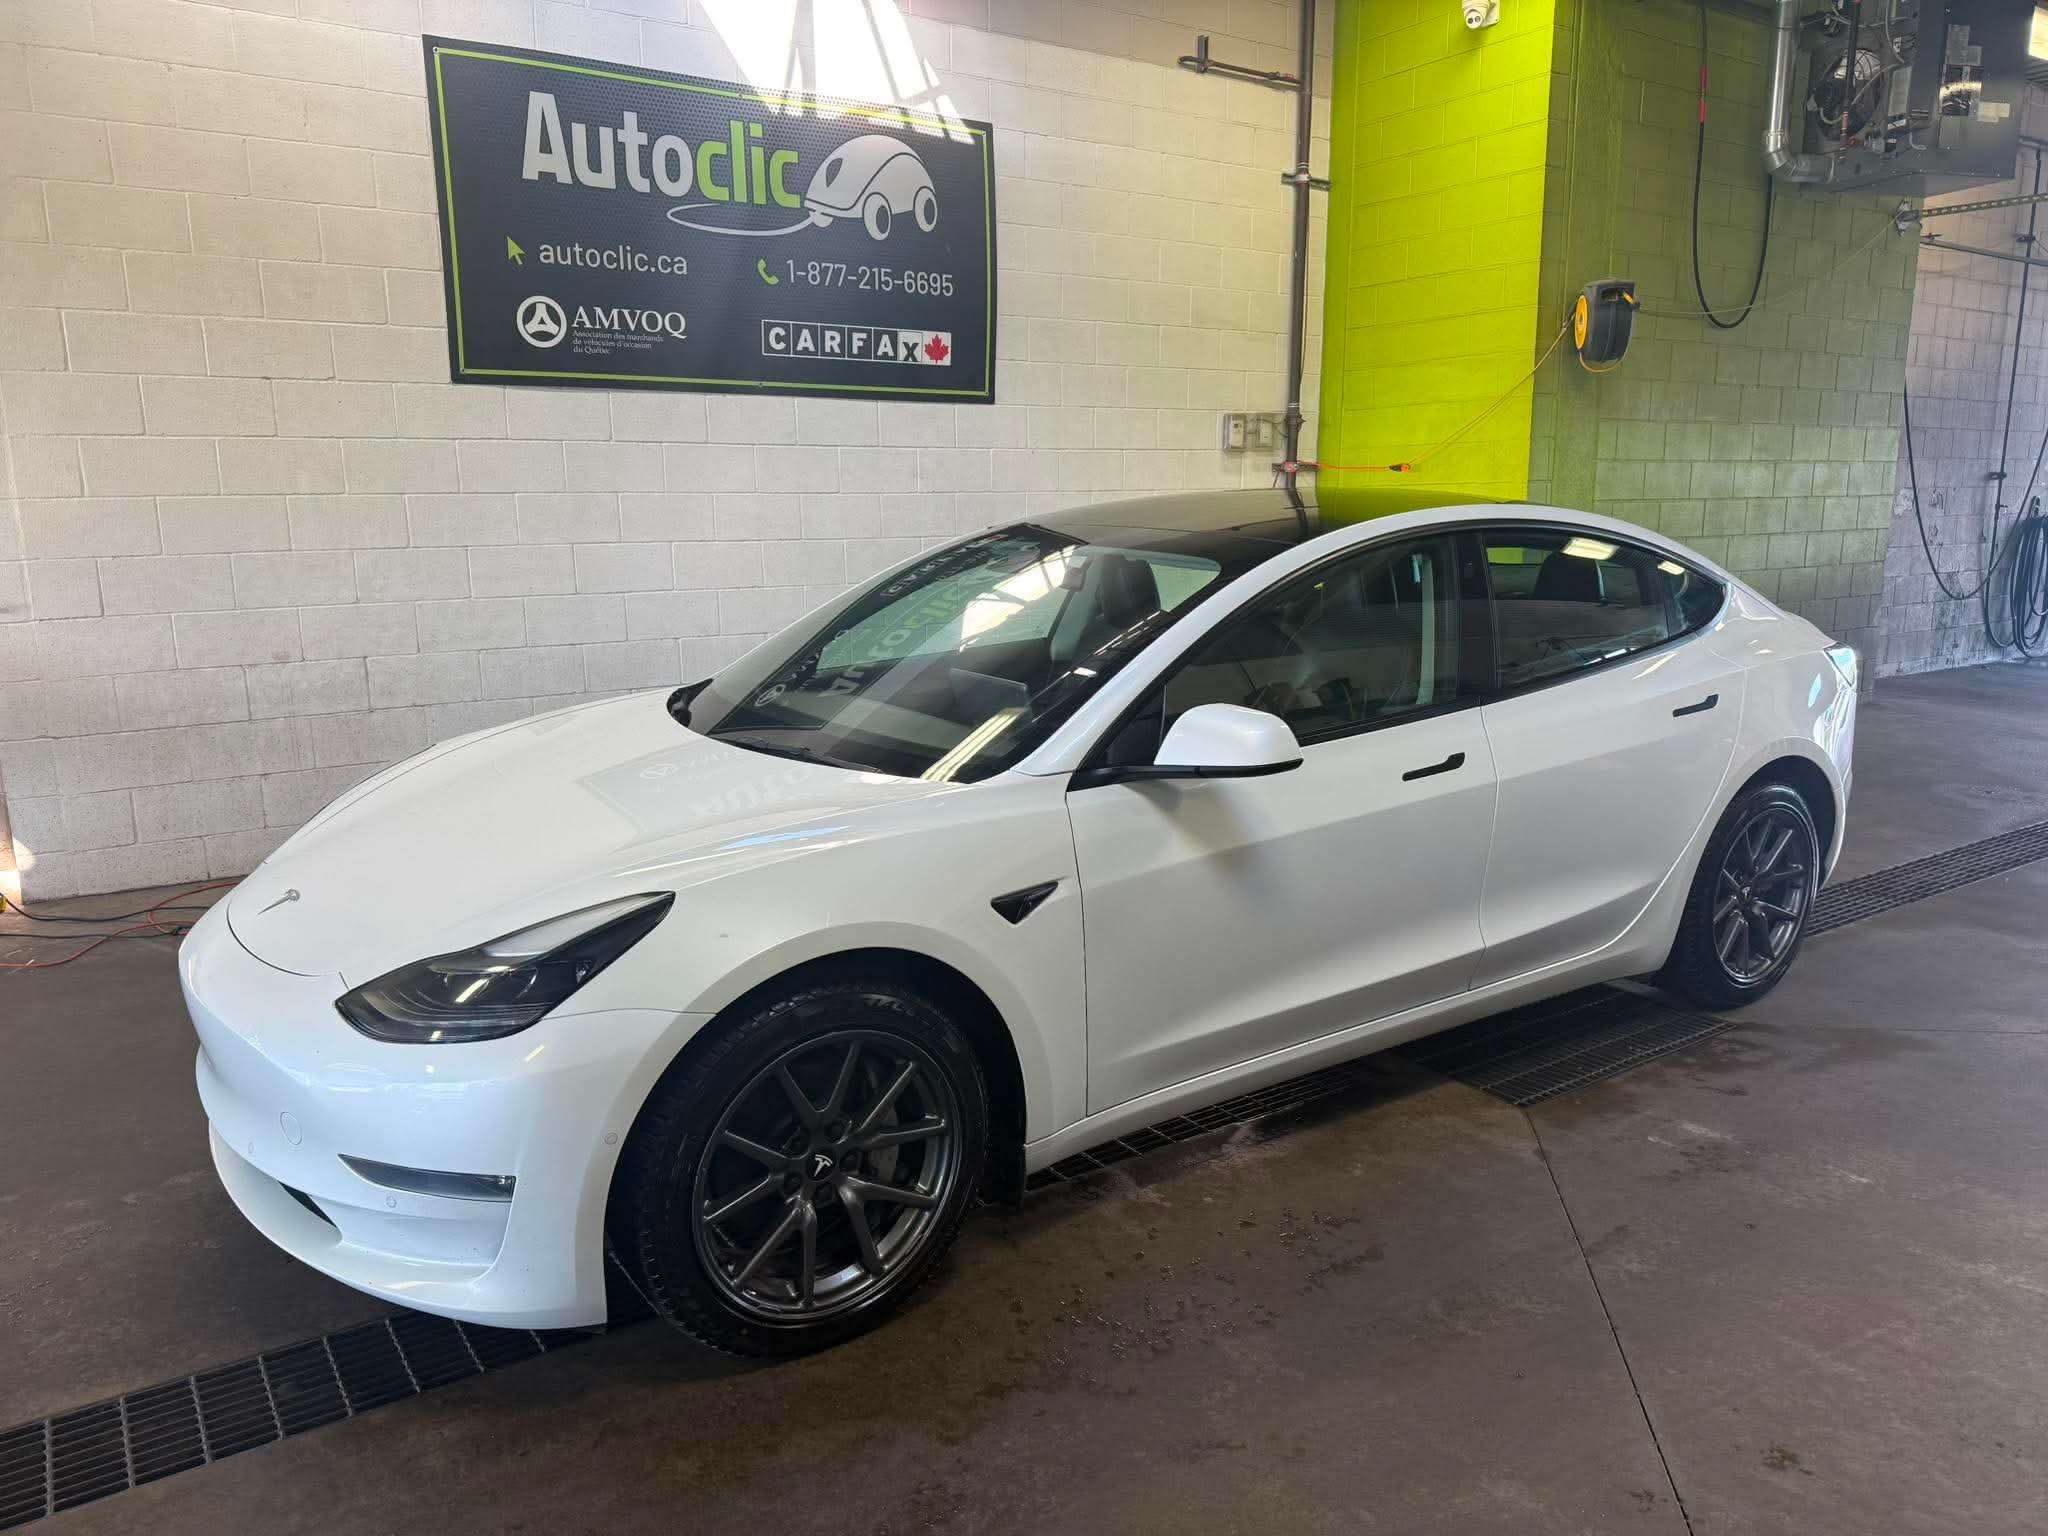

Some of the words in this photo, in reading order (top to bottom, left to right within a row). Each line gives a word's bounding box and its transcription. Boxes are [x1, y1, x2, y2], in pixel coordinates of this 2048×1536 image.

[522, 90, 801, 209] Autoclic
[539, 242, 688, 275] autoclic.ca
[786, 259, 954, 297] 1-877-215-6695
[571, 305, 688, 340] AMVOQ
[767, 326, 920, 363] CARFAX
